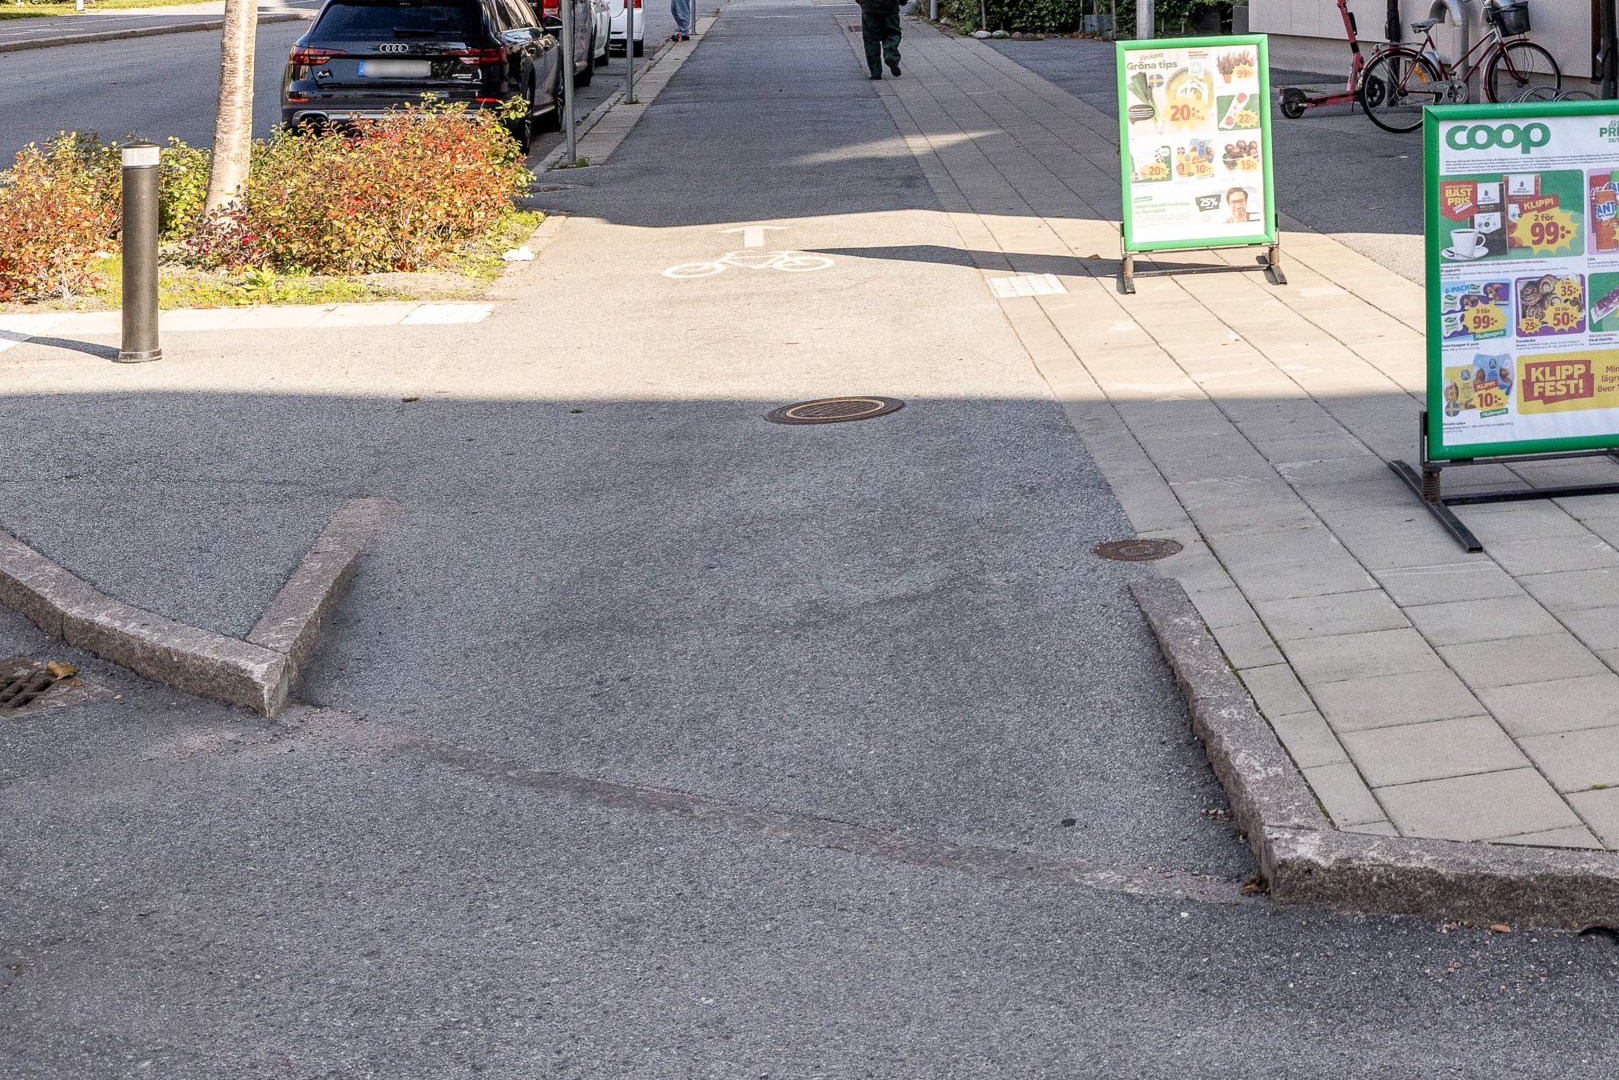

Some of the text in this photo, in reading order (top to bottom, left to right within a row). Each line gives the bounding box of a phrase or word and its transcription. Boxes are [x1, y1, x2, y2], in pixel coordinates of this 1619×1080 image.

[1126, 60, 1178, 70] Gröna tips
[1445, 122, 1551, 154] coop
[1445, 187, 1473, 198] BÄST
[1200, 197, 1218, 207] 25%
[1447, 197, 1471, 206] PRIS
[1523, 197, 1554, 210] KLIPP!
[1530, 363, 1586, 382] KLIPP
[1533, 379, 1584, 397] FEST!
[1597, 384, 1615, 393] över
